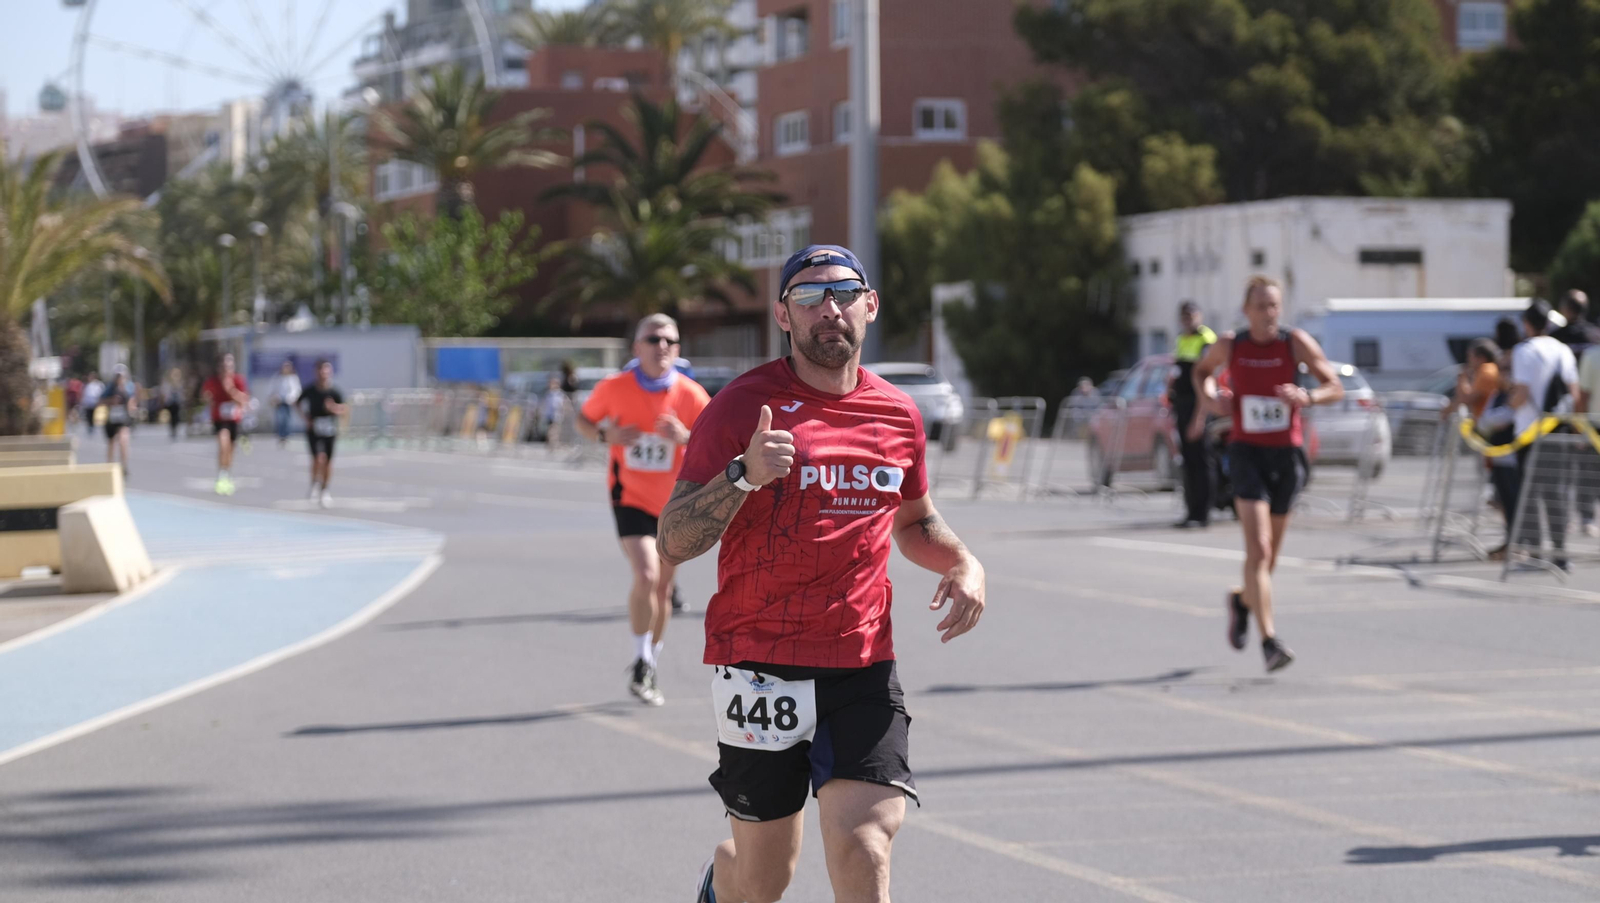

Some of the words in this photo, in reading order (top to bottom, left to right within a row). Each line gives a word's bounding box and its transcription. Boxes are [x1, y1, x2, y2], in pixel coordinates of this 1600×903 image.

[631, 444, 667, 463] 413
[800, 464, 904, 493] PULSO
[832, 497, 877, 506] RUNNING
[726, 694, 799, 731] 448
